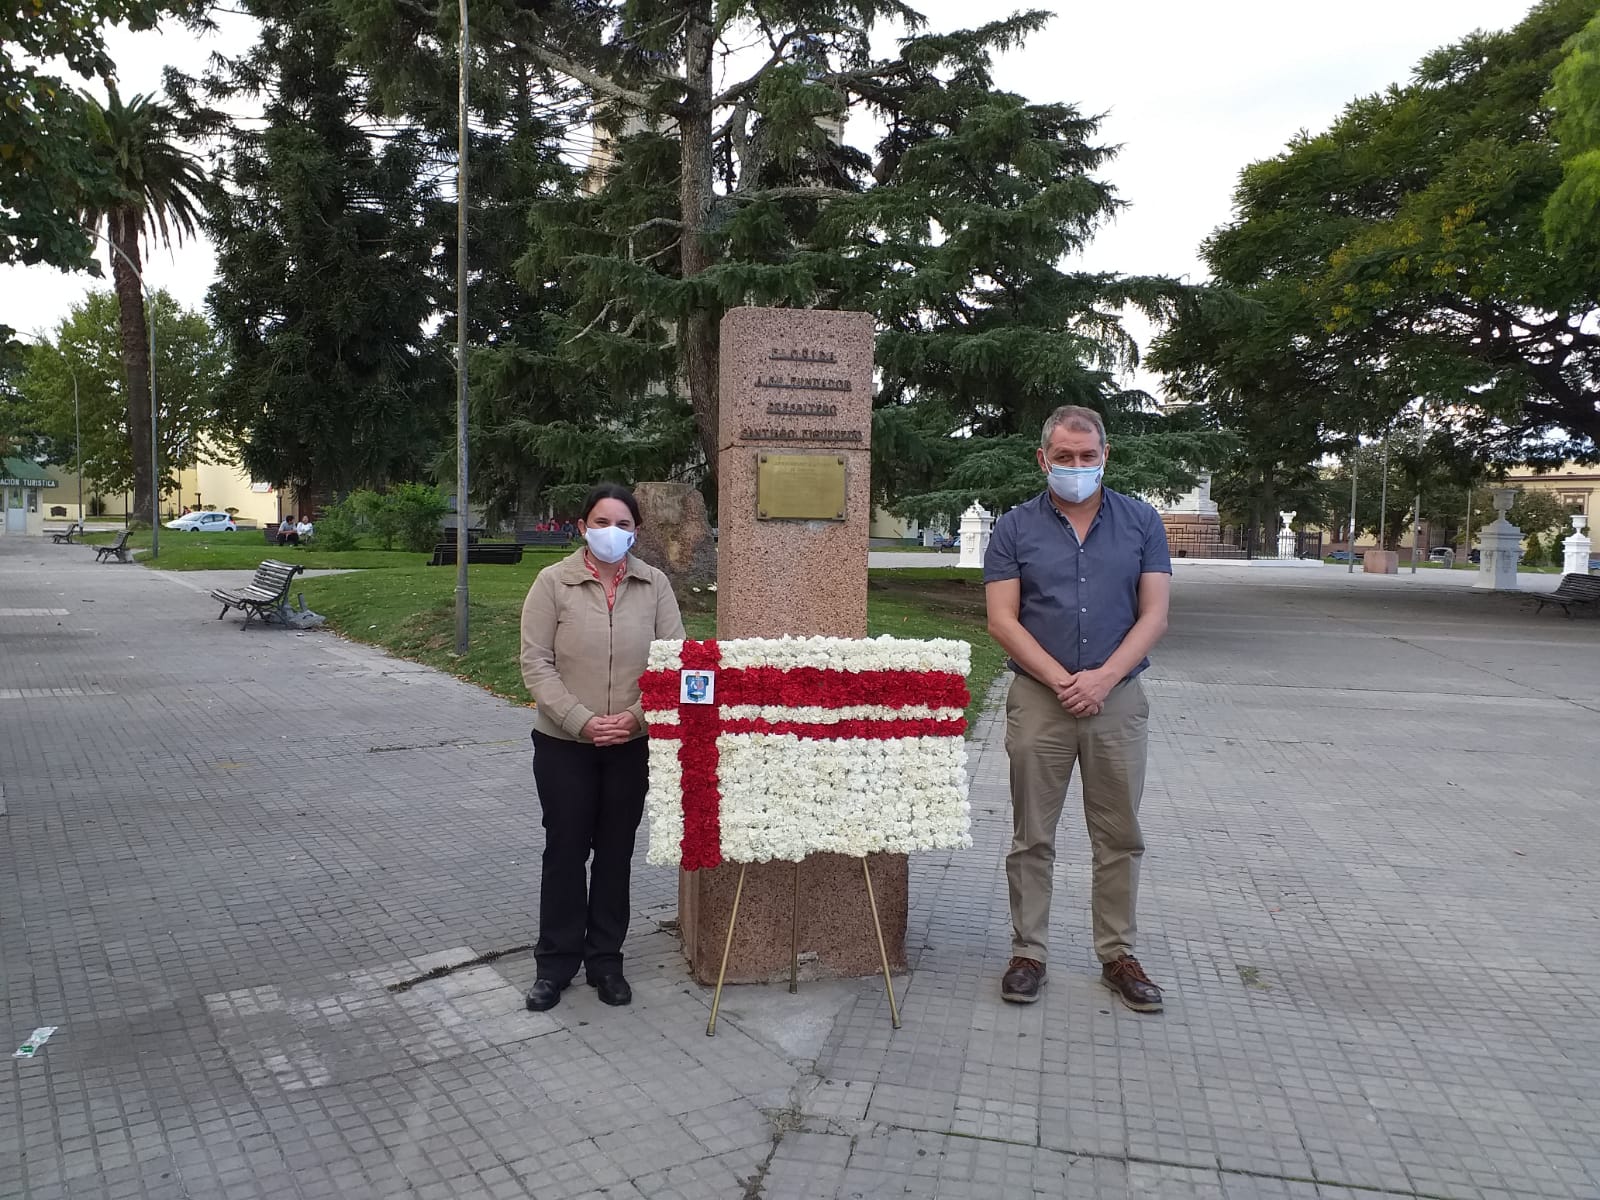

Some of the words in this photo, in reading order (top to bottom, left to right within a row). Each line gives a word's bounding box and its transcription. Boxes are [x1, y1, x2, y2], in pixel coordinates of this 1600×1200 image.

[790, 377, 852, 389] FUNDADOR
[767, 402, 837, 415] PRESBITERO
[741, 428, 795, 439] SANTIAGO
[23, 479, 56, 487] TURISTICA
